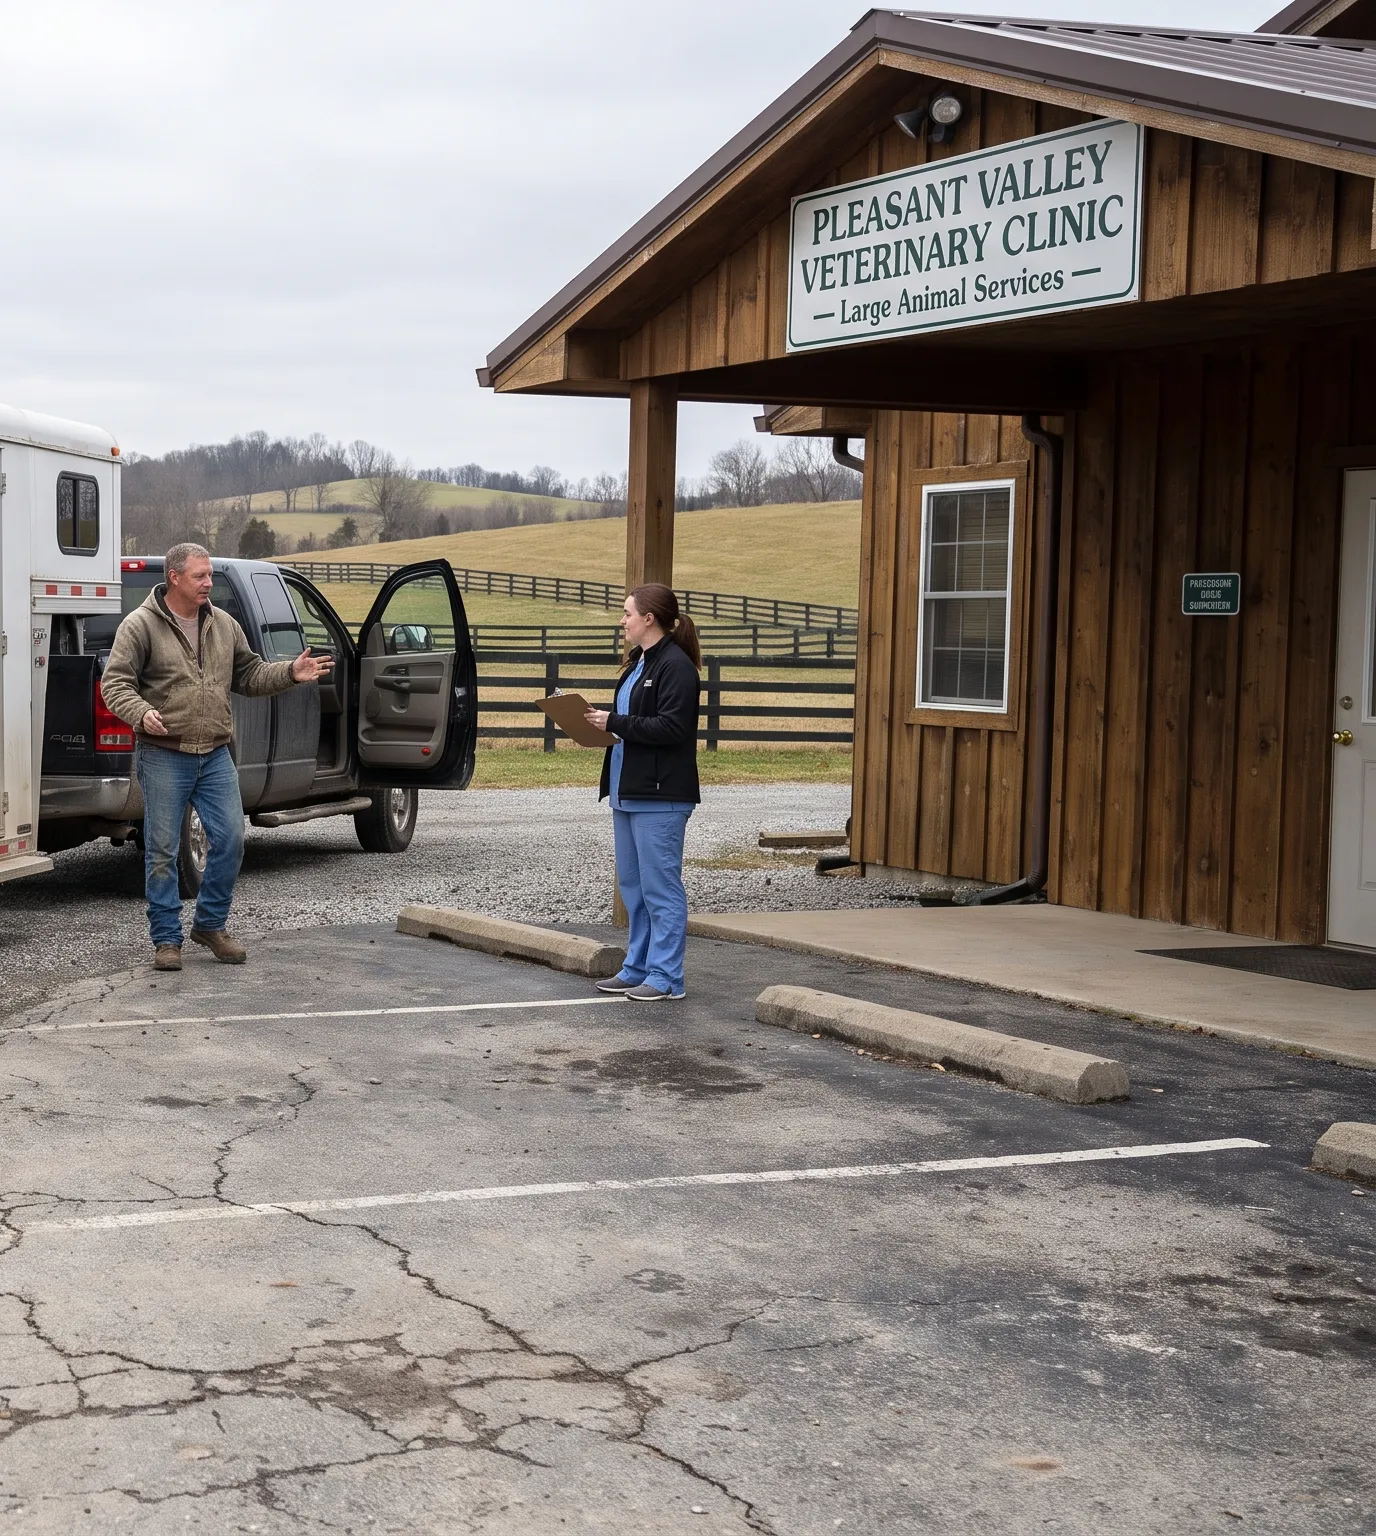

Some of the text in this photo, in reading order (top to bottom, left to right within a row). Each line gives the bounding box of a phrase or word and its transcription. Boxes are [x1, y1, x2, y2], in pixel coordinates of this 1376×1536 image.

[812, 139, 1114, 246] PLEASANT VALLEY
[800, 194, 1124, 294] VETERINARY CLINIC
[840, 267, 1064, 326] Large Animal Services
